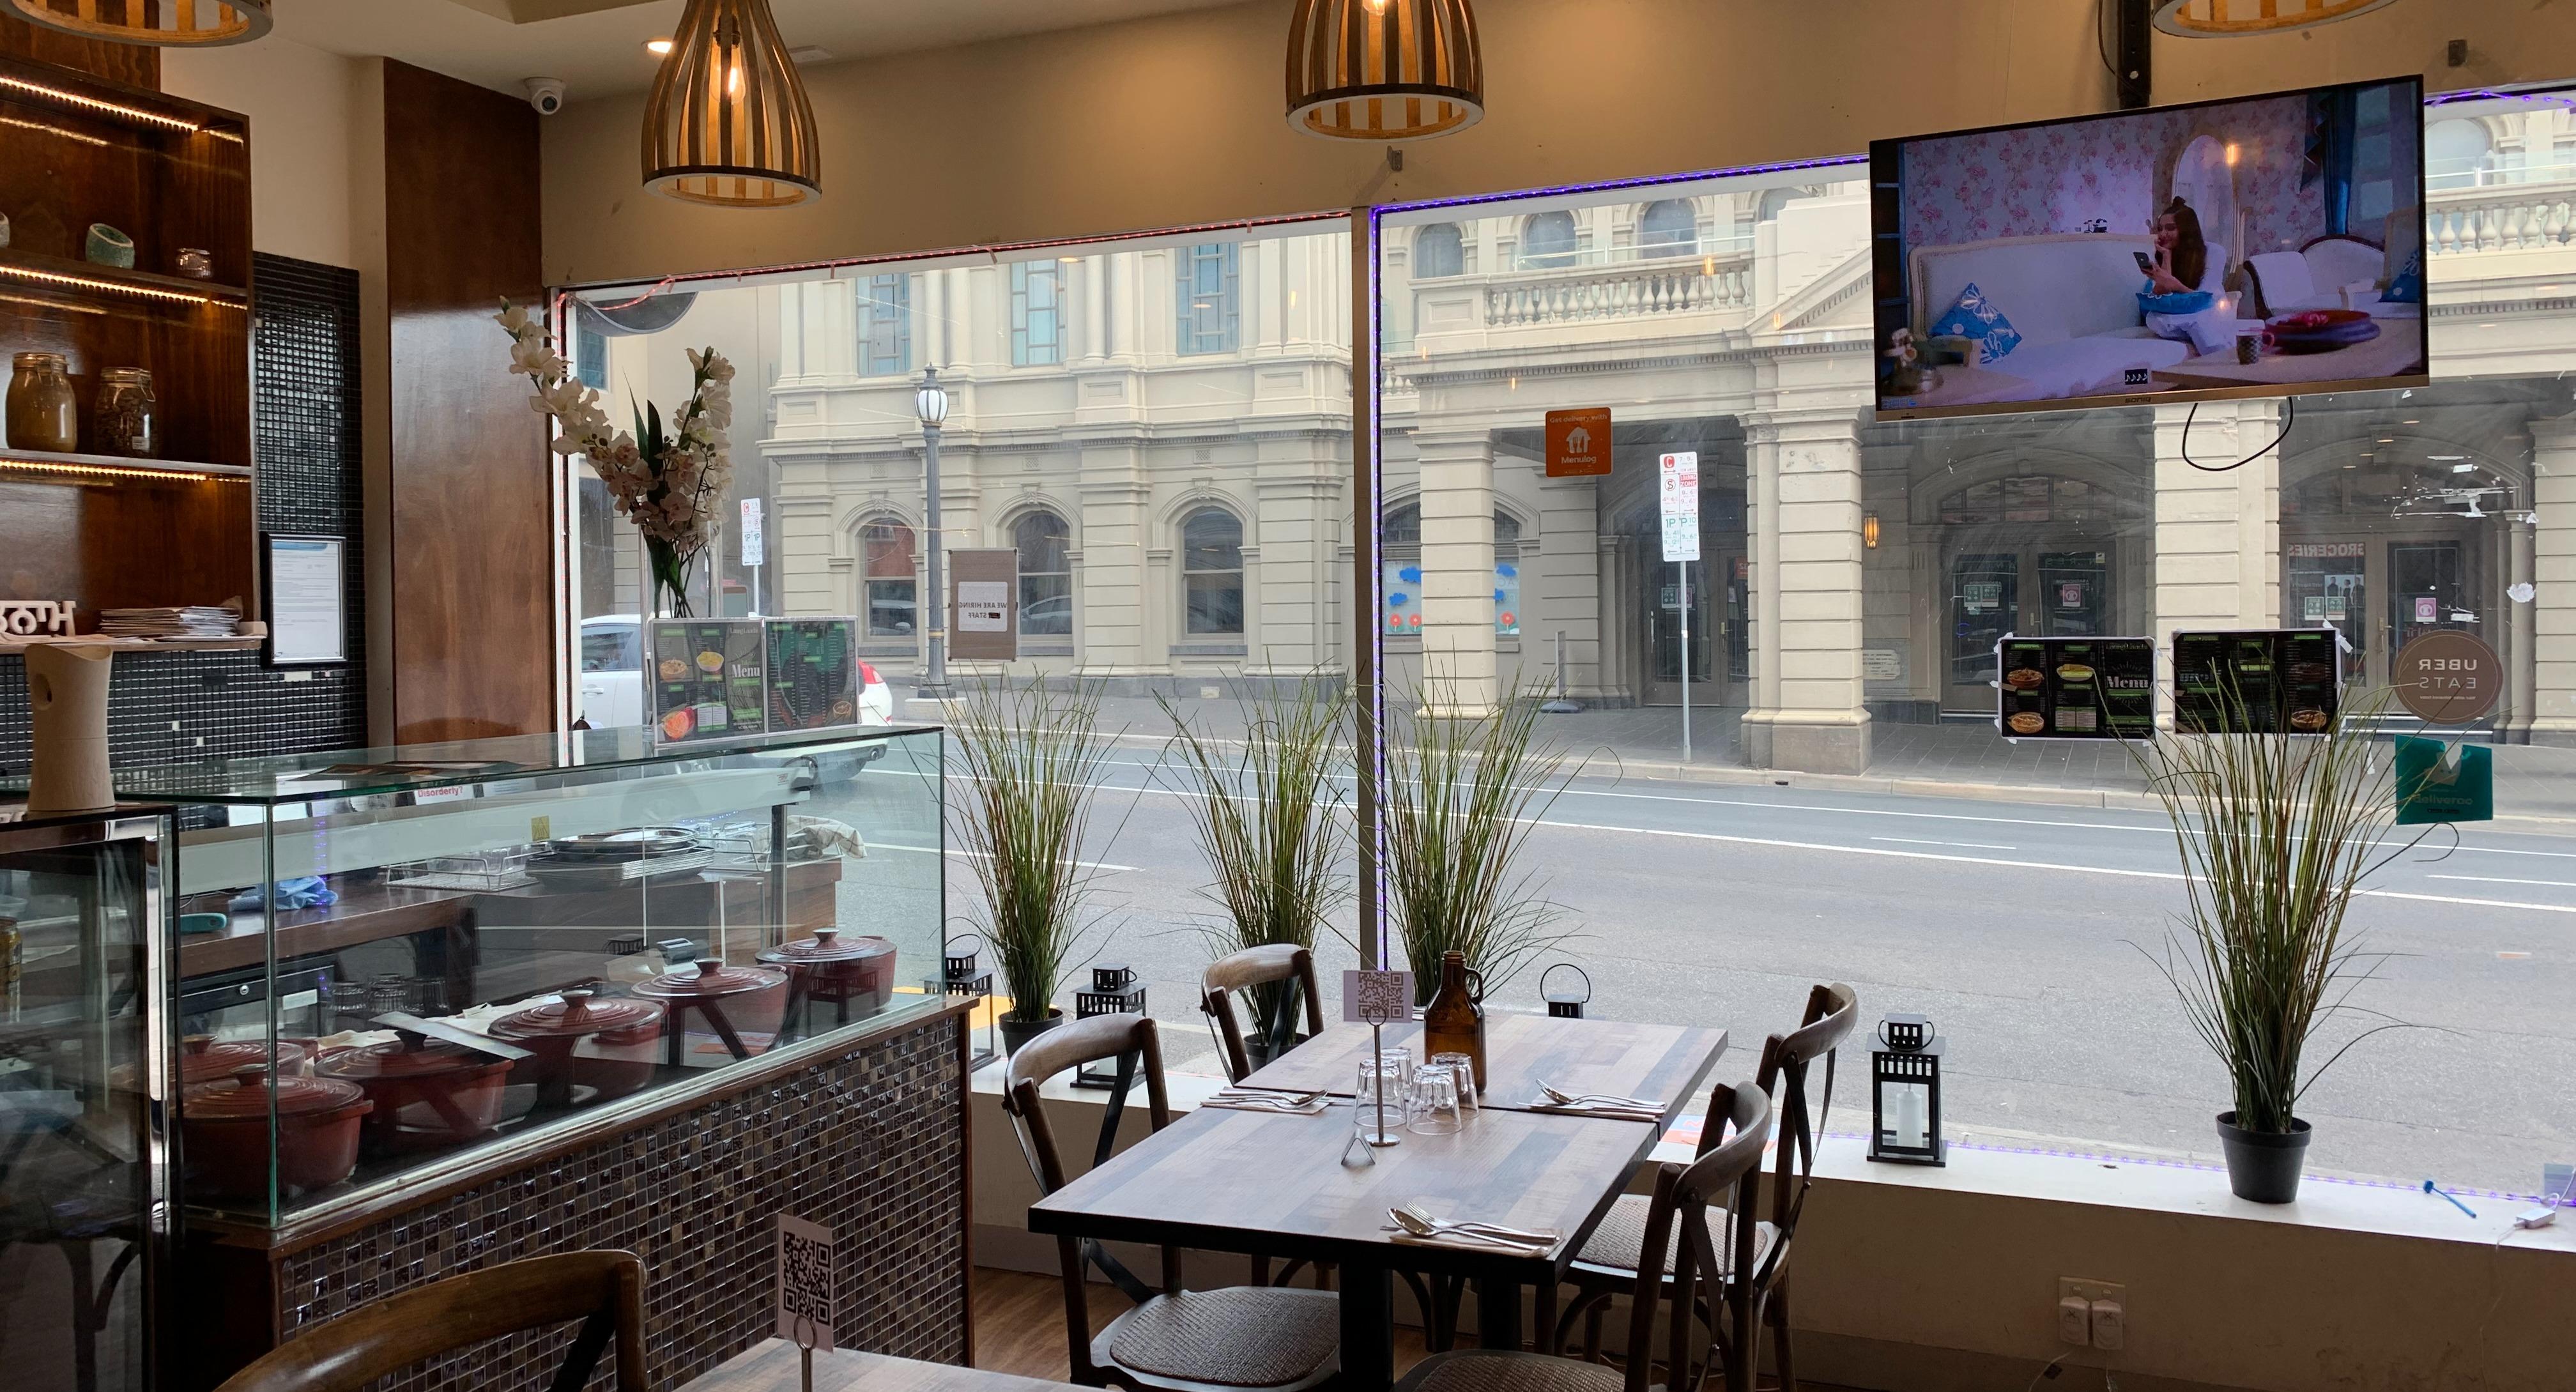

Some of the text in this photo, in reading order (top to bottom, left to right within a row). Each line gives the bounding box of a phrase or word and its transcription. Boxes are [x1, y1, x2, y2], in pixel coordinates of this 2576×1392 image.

[1561, 455, 1597, 464] Menulog
[1666, 518, 1676, 528] 1P
[732, 664, 761, 678] Menu
[2106, 676, 2149, 688] Menu
[417, 786, 464, 798] Disorderly?
